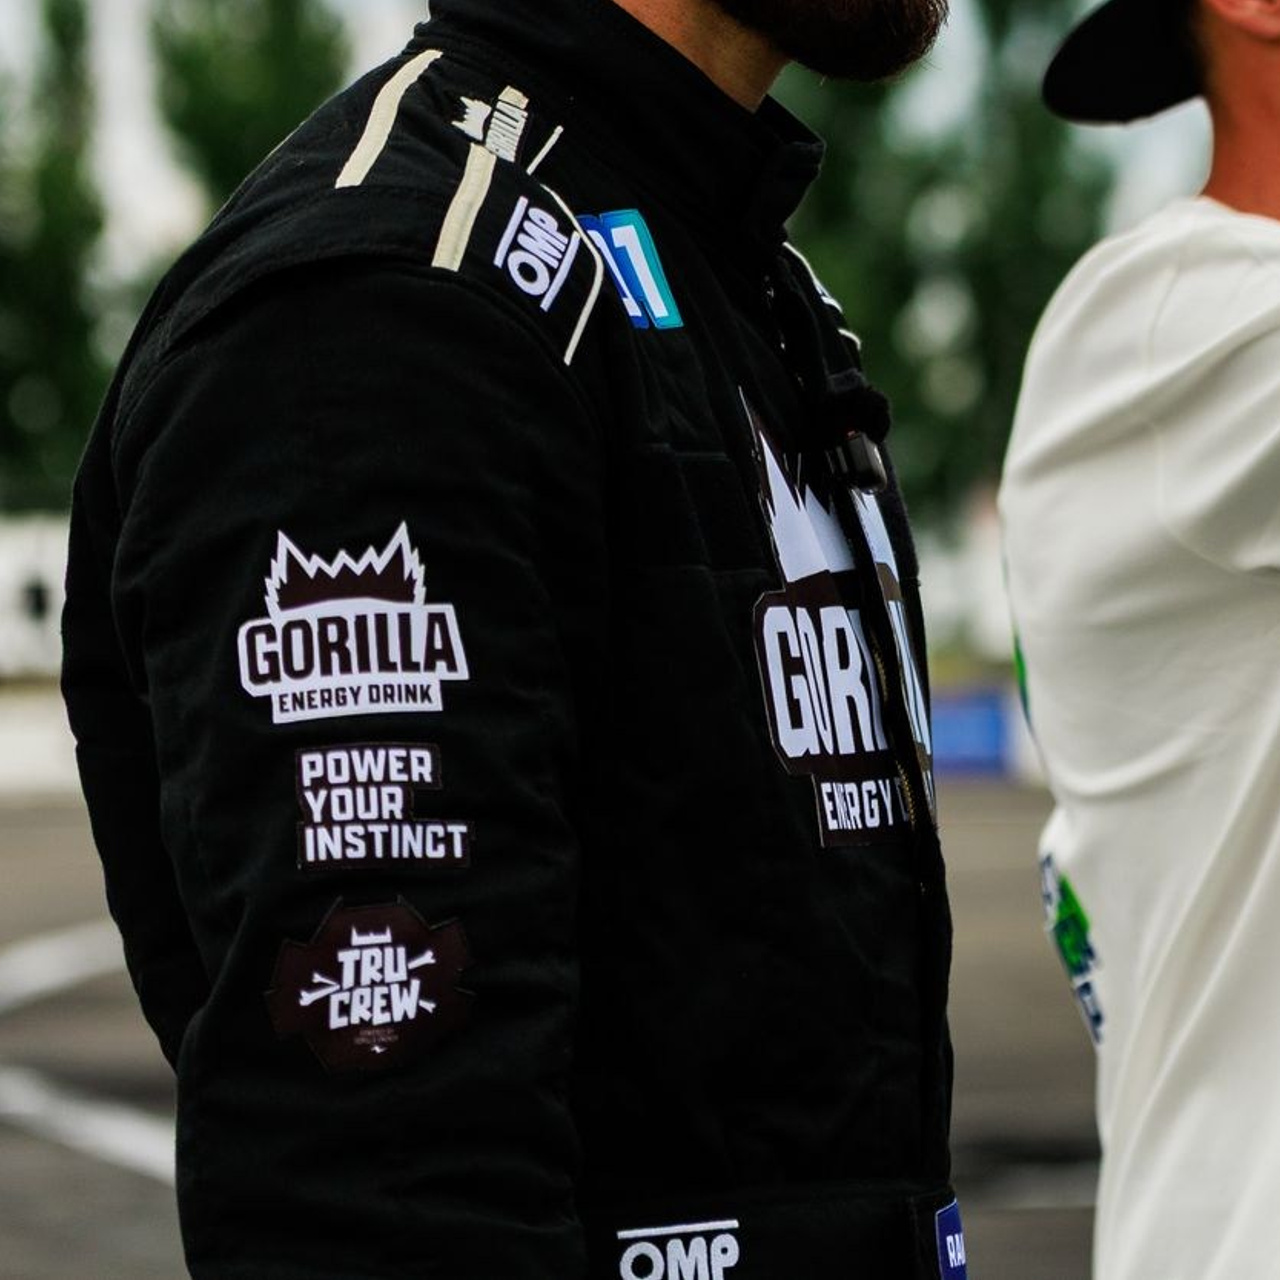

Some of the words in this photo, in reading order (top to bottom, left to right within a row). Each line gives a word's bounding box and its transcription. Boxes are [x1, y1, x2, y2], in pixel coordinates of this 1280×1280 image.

[507, 206, 570, 296] OMP
[245, 611, 459, 686] GORILLA
[278, 684, 363, 714] ENERGY
[368, 683, 434, 705] DRINK
[301, 747, 434, 787] POWER
[304, 785, 404, 824] YOUR
[304, 823, 468, 862] INSTINCT
[338, 946, 409, 991] TRU
[329, 978, 421, 1030] CREW
